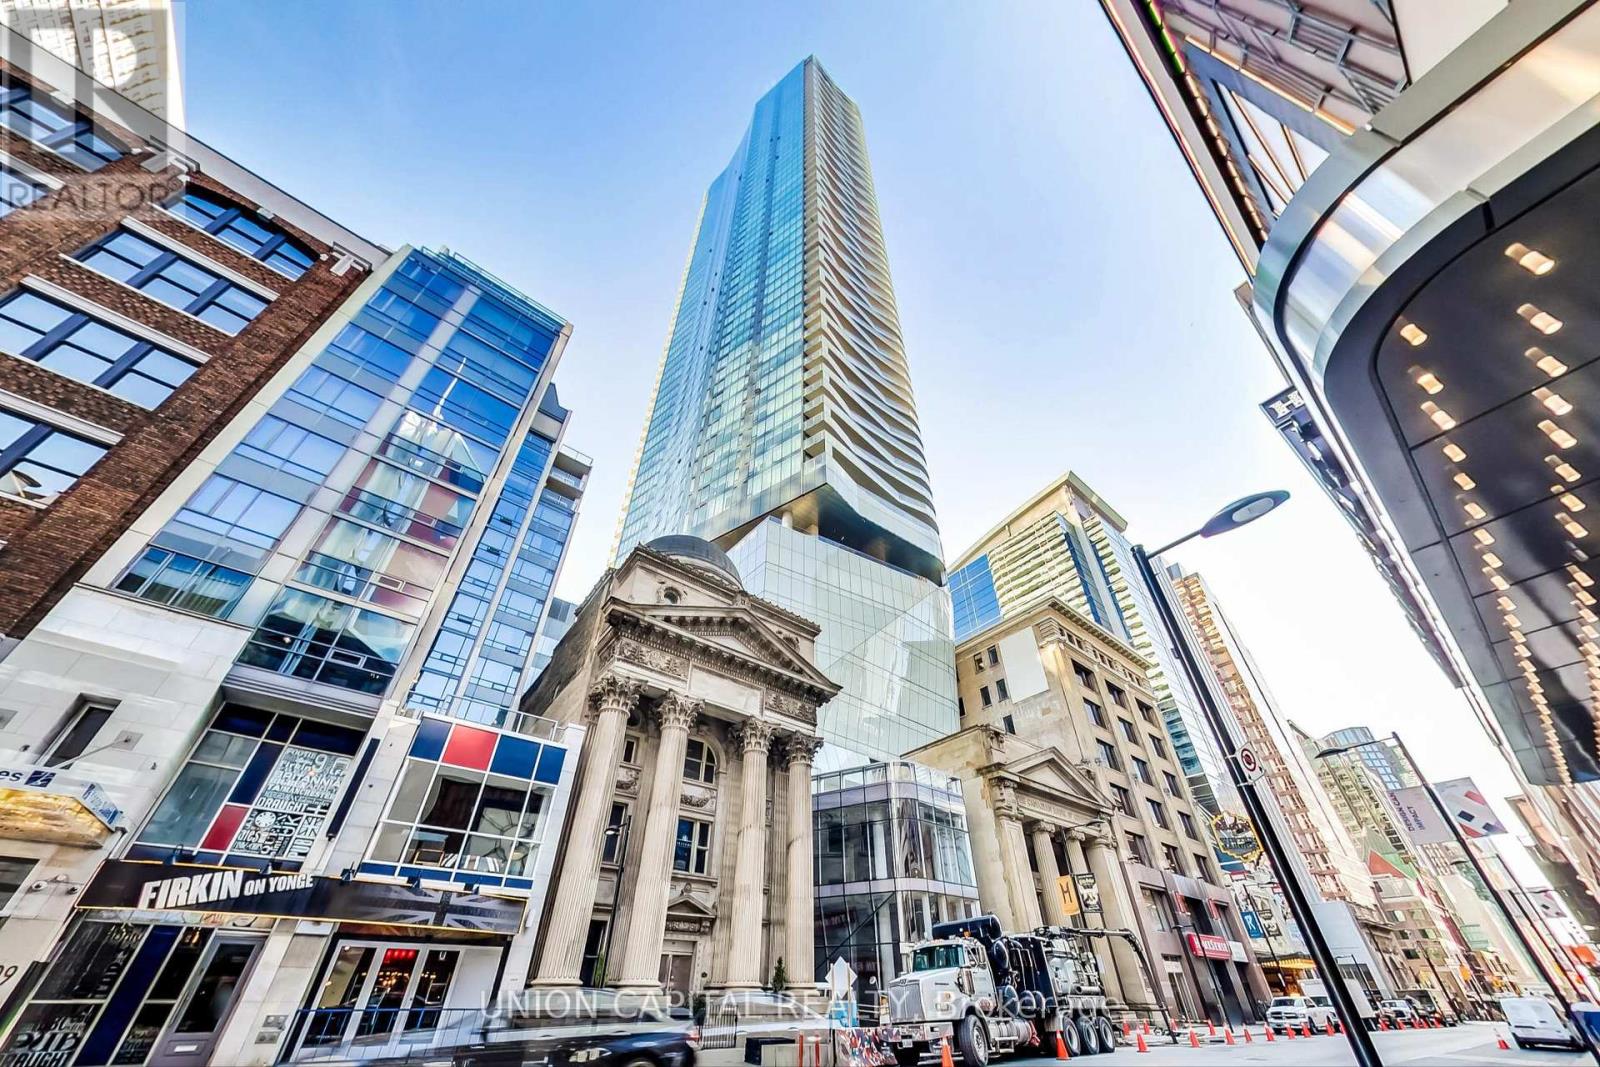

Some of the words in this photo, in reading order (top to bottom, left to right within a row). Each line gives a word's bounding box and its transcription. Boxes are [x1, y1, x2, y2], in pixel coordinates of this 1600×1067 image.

[256, 797, 309, 813] DRAUGHT
[137, 870, 244, 910] FIRKIN
[244, 878, 267, 896] ON
[268, 874, 314, 893] YONGE
